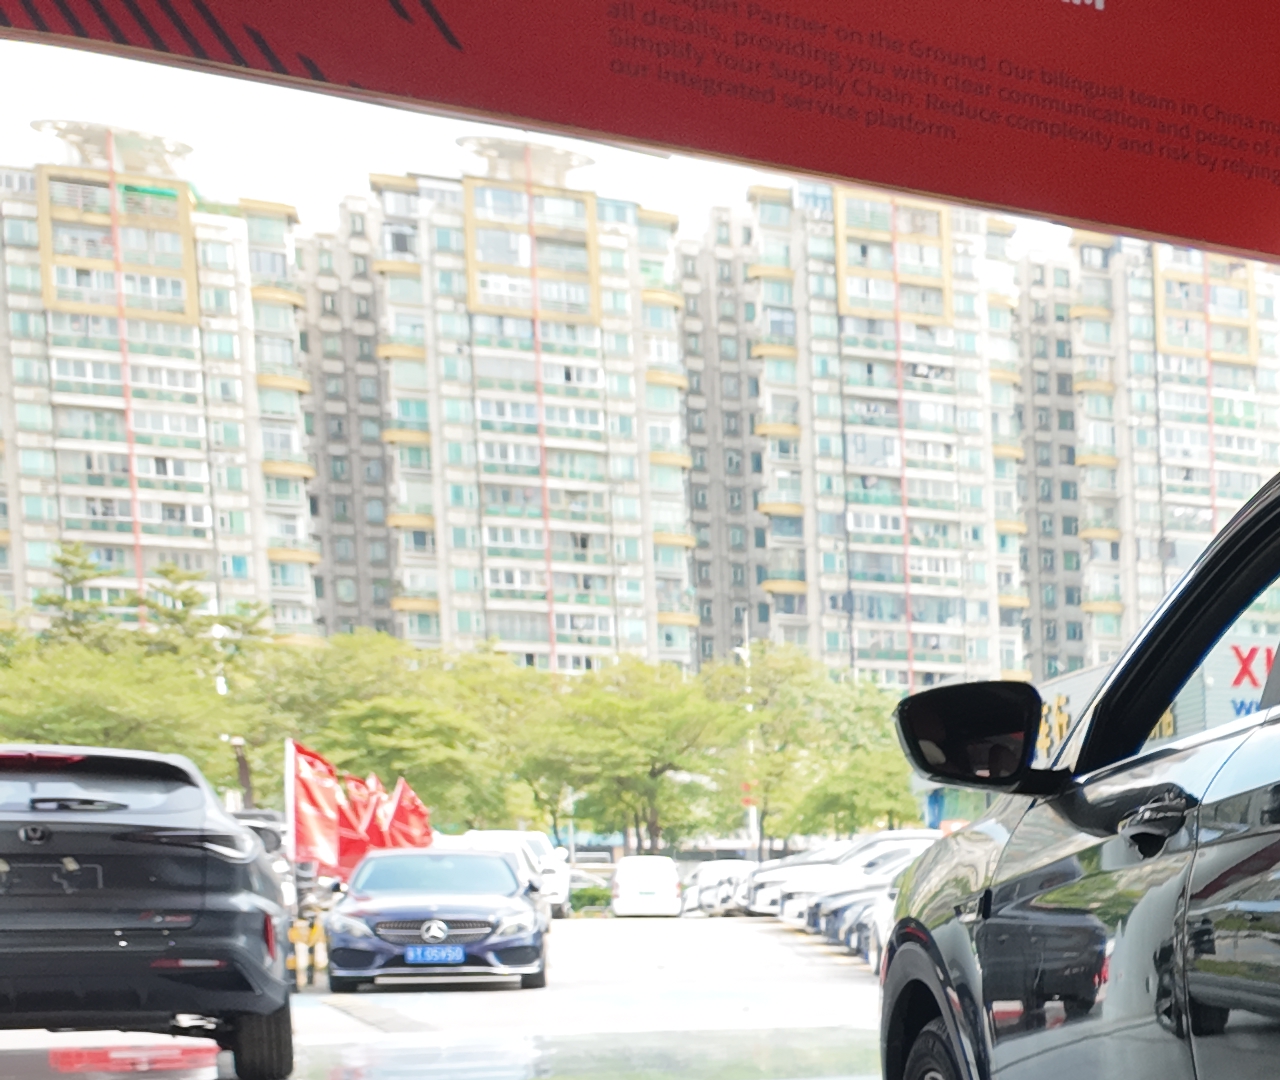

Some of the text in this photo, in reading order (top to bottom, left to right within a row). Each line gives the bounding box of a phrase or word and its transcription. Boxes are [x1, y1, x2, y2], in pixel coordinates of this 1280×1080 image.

[607, 2, 635, 21] all
[734, 30, 841, 70] providing
[849, 54, 886, 75] you
[893, 60, 938, 86] with
[943, 74, 992, 97] clear
[998, 85, 1151, 131] communication
[1156, 118, 1191, 140] and
[1195, 128, 1250, 151] peace
[1254, 138, 1270, 157] of
[608, 26, 706, 66] Simplify
[712, 47, 762, 74] Your
[769, 61, 847, 95] Supply
[926, 94, 1003, 125] Reduce
[1006, 113, 1114, 151] complexity
[1118, 135, 1153, 156] and
[1158, 143, 1191, 163] risk
[1198, 149, 1218, 173] by
[609, 58, 648, 77] our
[782, 93, 859, 121] service
[747, 2, 828, 33] Partner
[834, 26, 863, 45] on
[869, 30, 903, 52] the
[998, 58, 1034, 81] Our
[1040, 69, 1124, 101] bilingual
[1129, 88, 1176, 112] team
[1181, 97, 1198, 117] in
[1203, 102, 1254, 130] China
